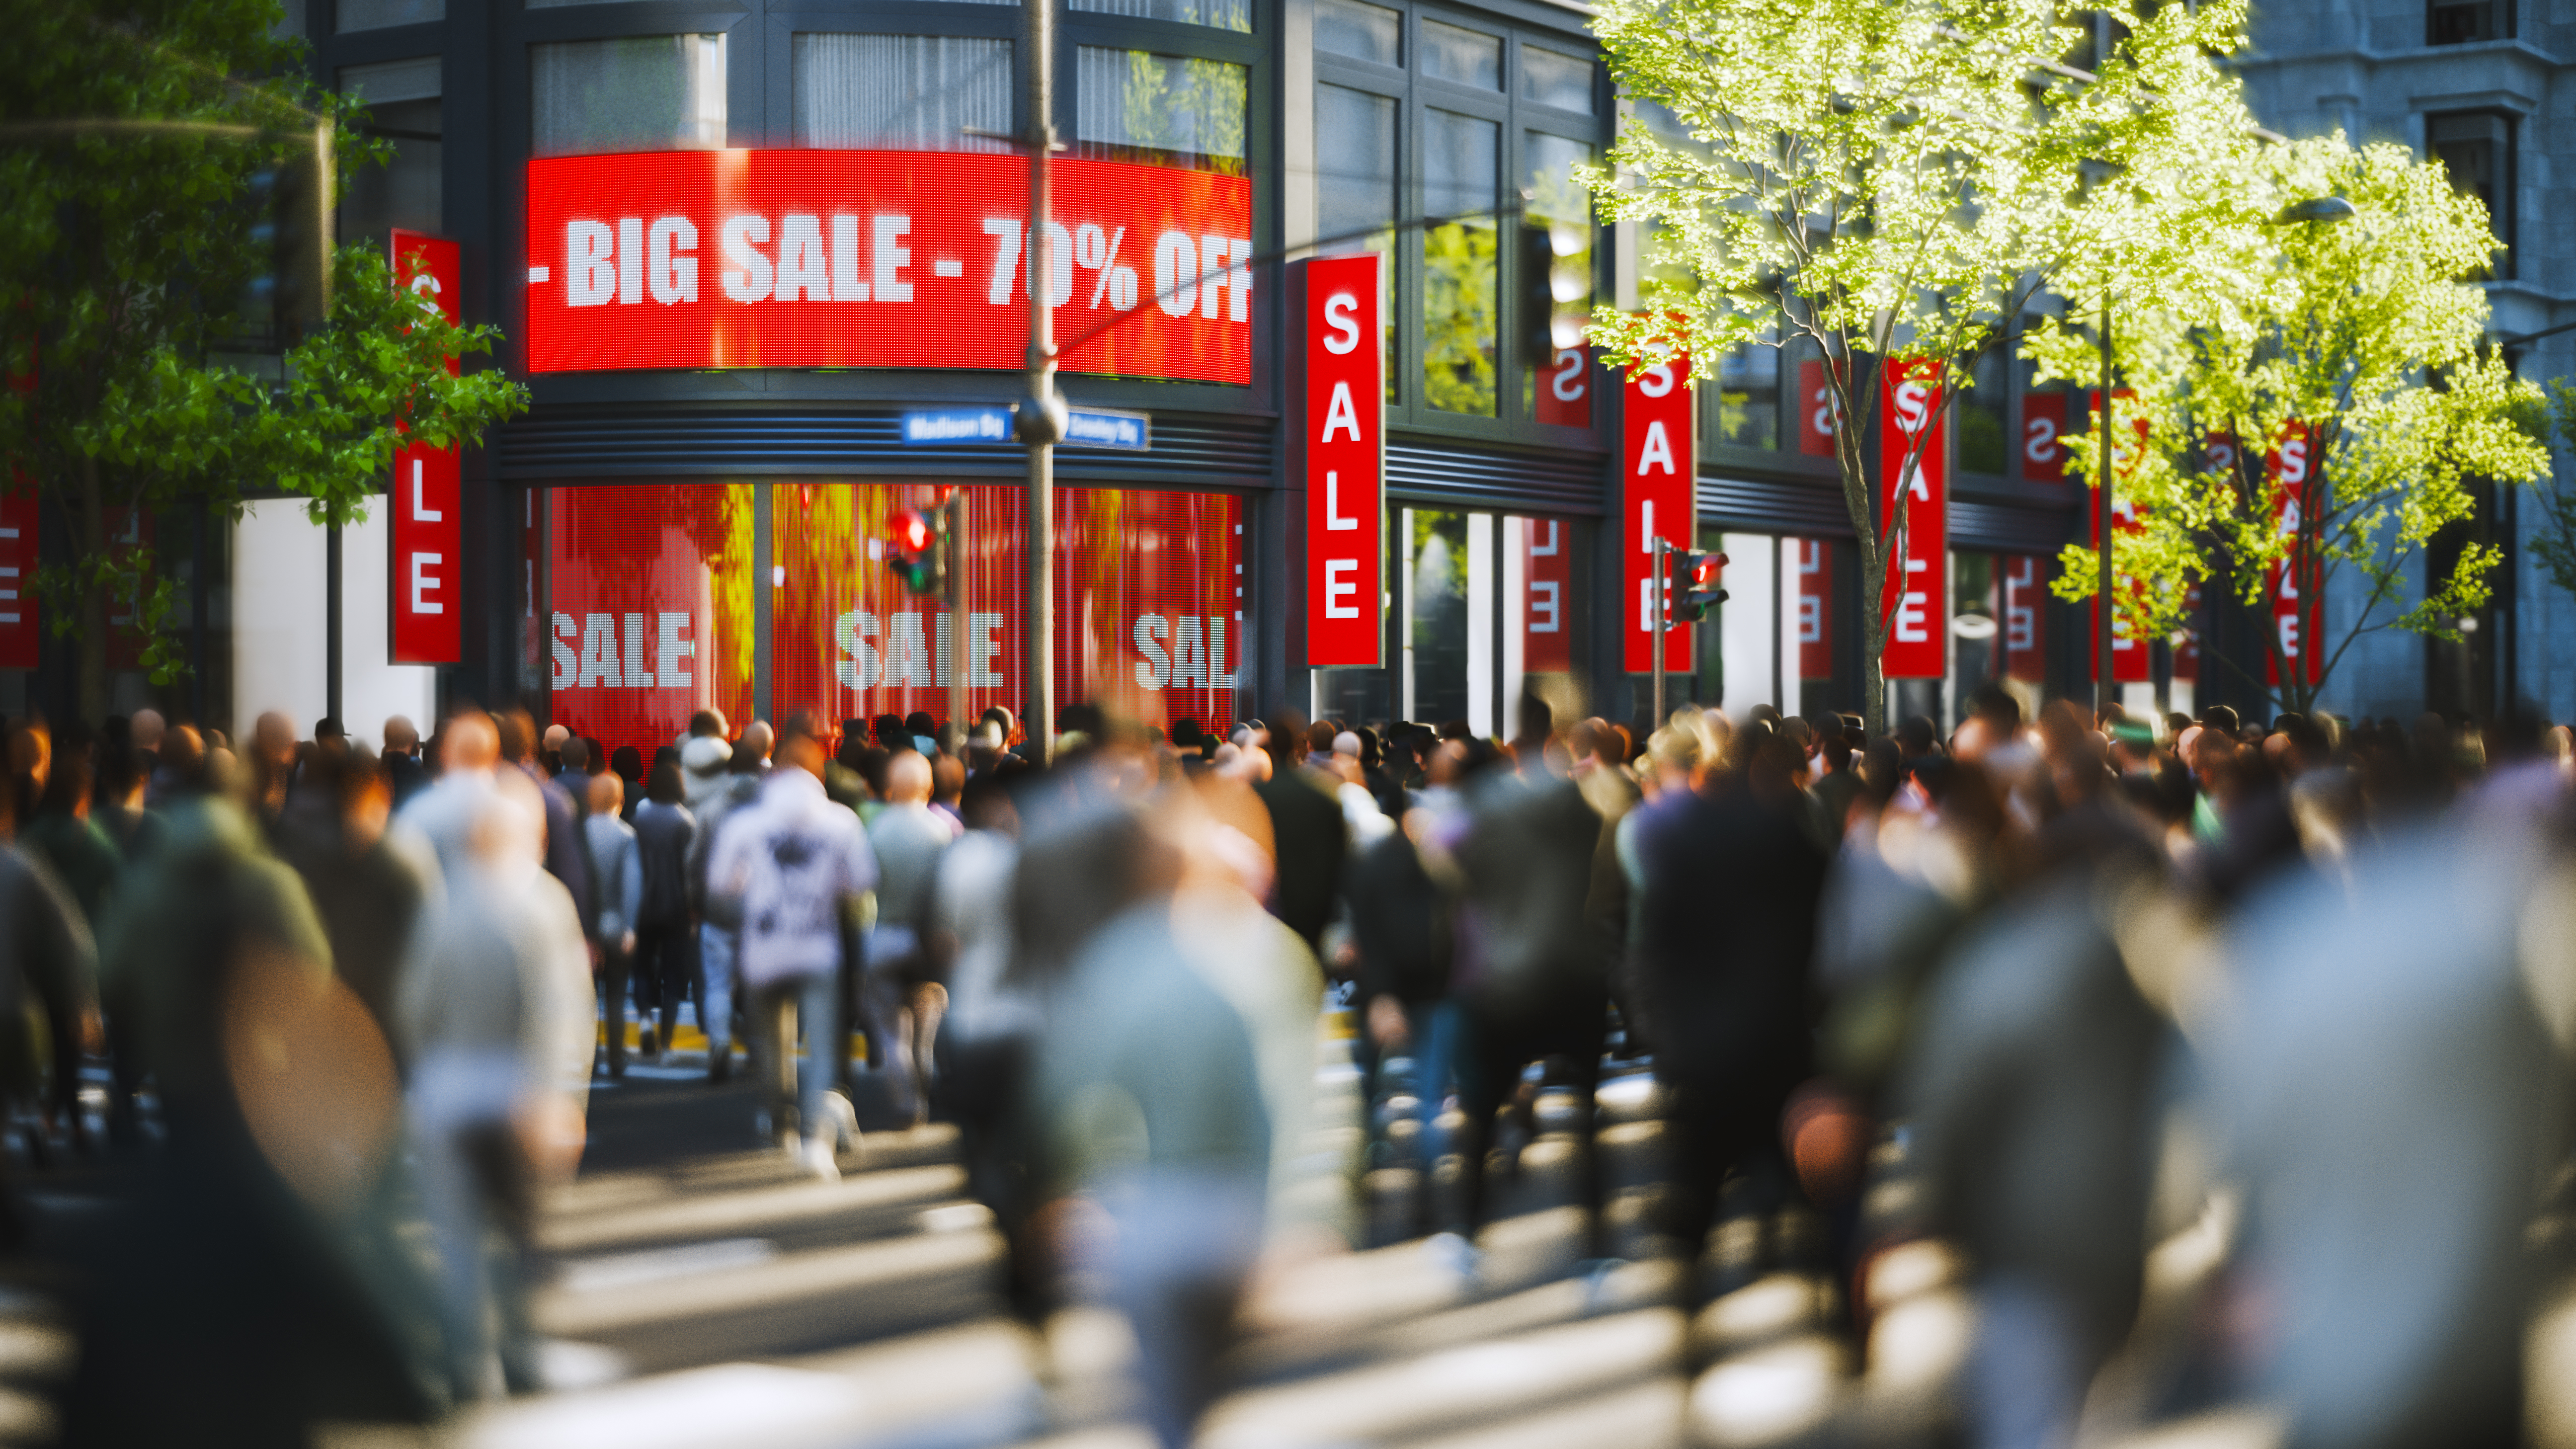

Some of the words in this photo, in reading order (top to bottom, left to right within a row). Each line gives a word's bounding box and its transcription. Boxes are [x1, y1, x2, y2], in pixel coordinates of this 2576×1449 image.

[567, 216, 698, 306] BIG
[721, 214, 914, 305] SALE
[983, 218, 1140, 311] 70%
[1155, 231, 1253, 323] OFF
[411, 274, 443, 614] SLE
[1322, 293, 1360, 619] SALE
[1894, 384, 1929, 642] SALE
[552, 611, 692, 690] SALE
[835, 609, 1004, 690] SALE
